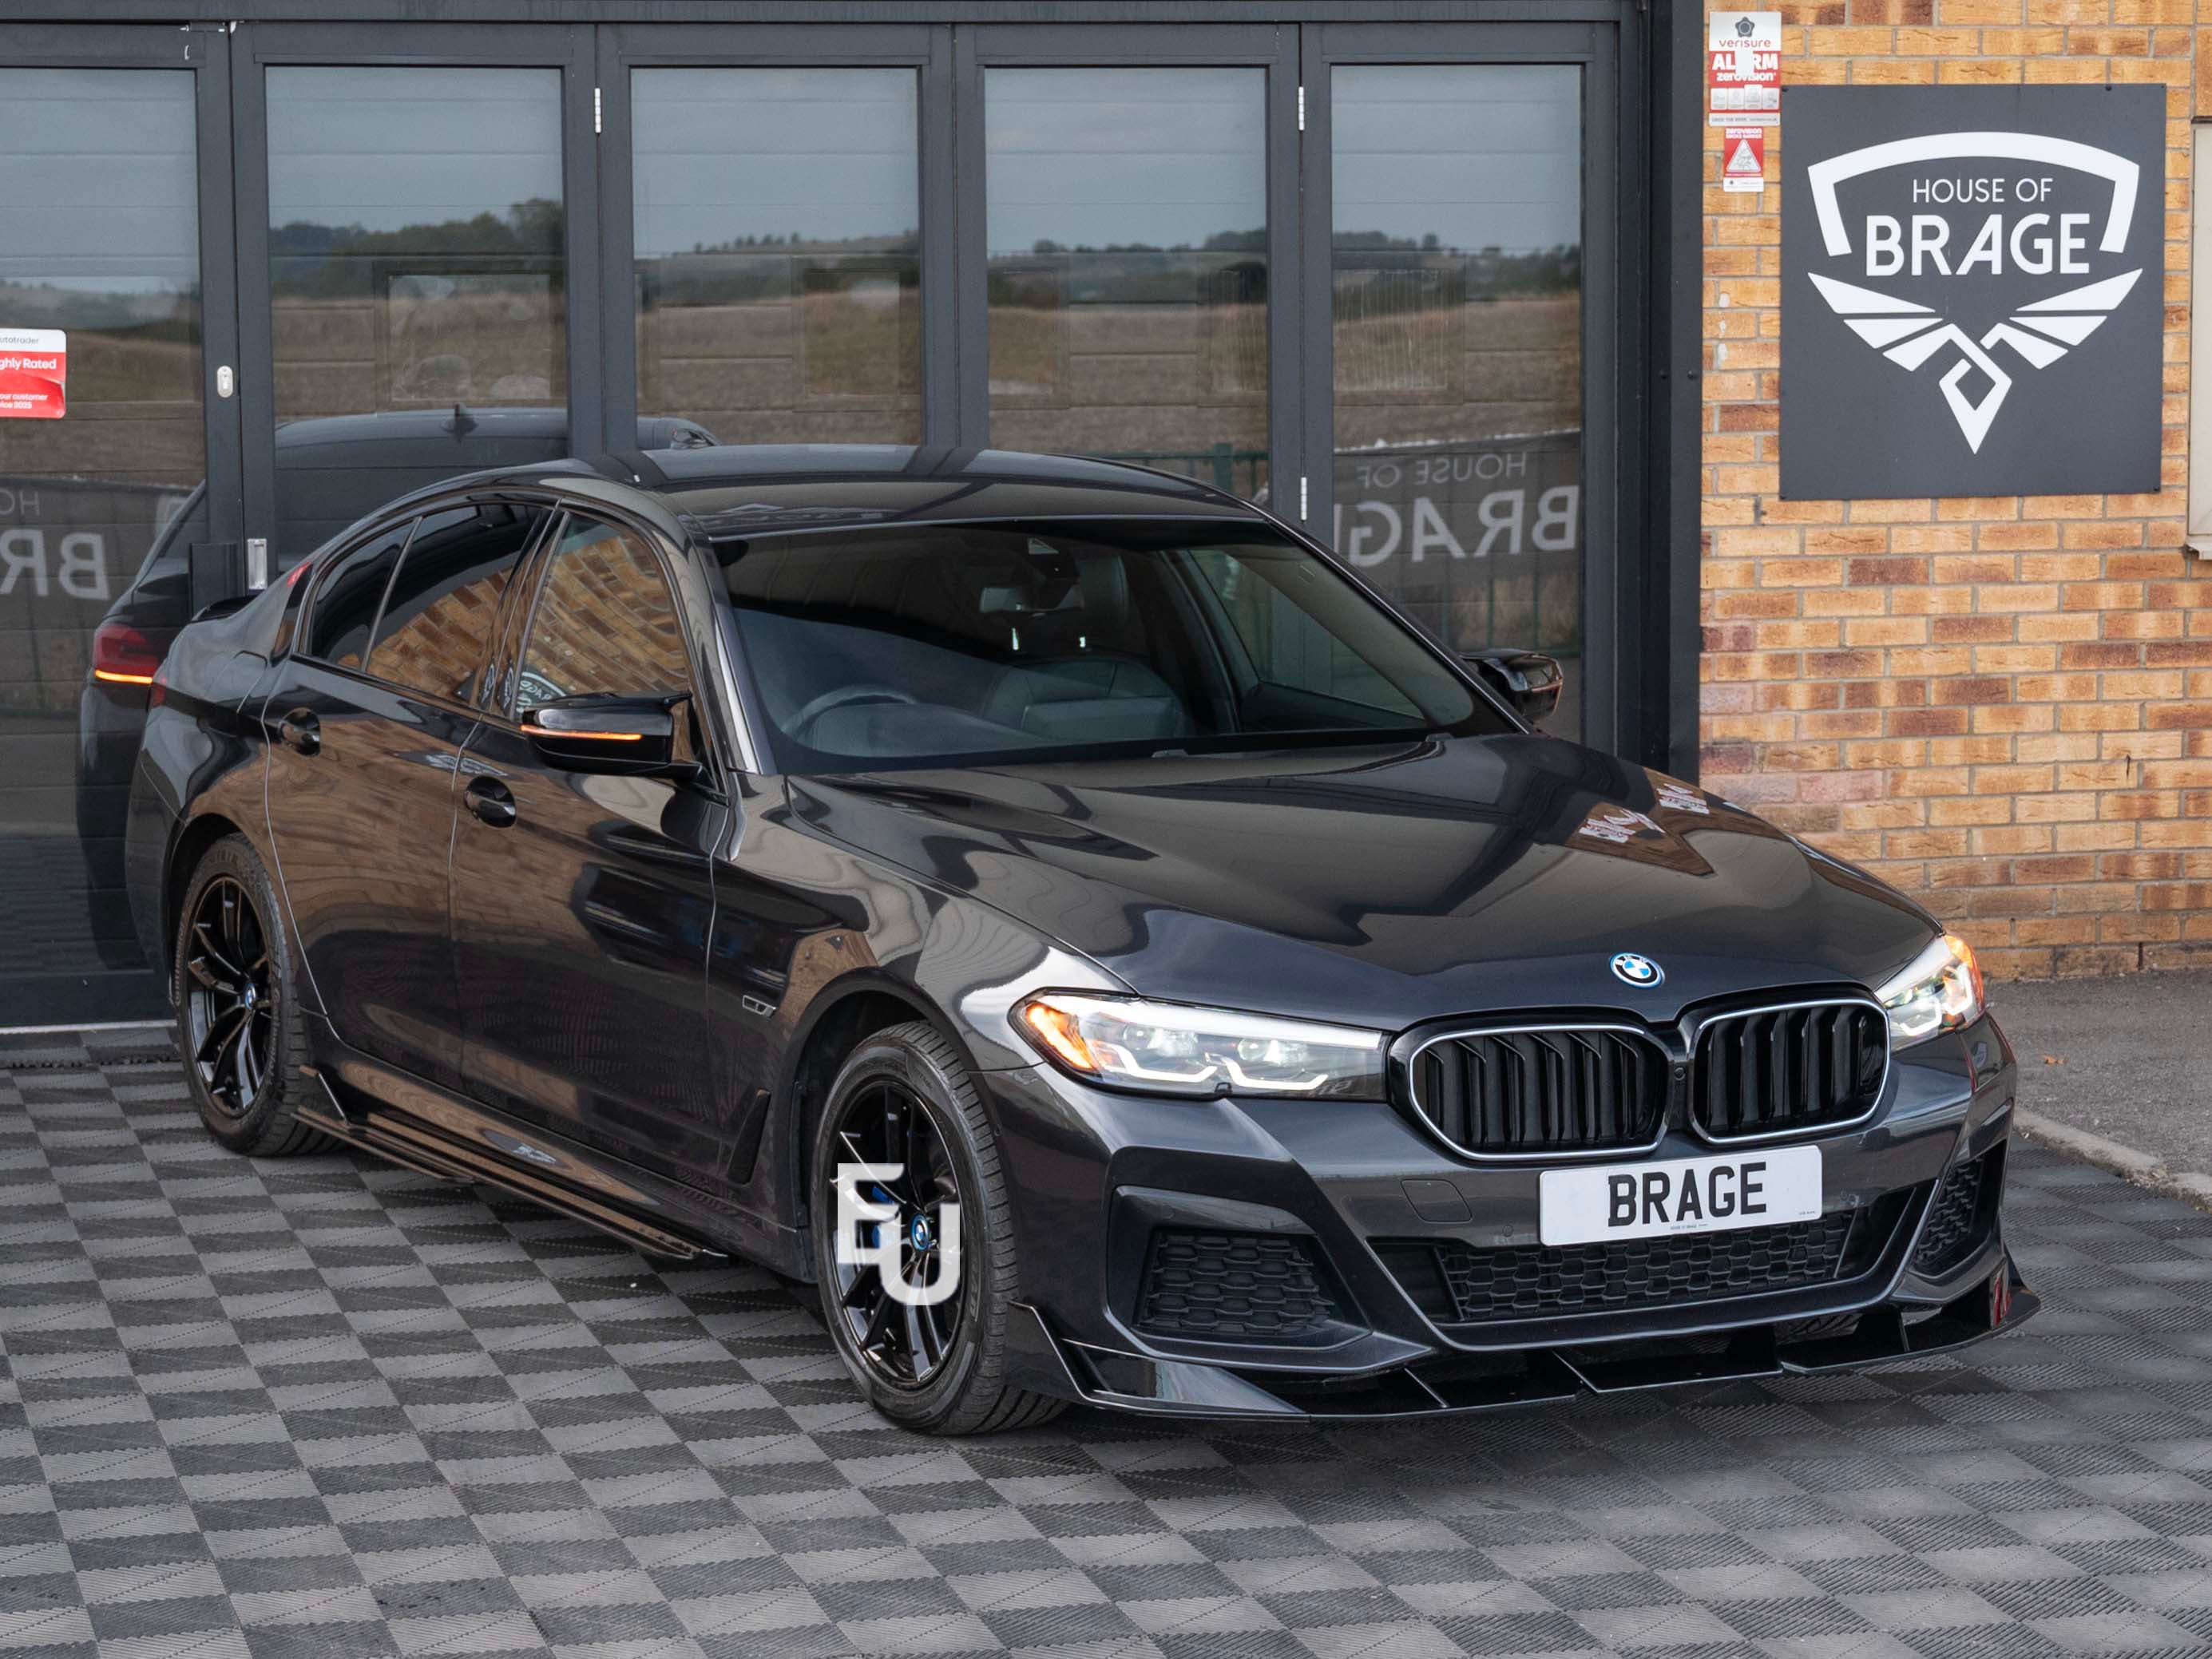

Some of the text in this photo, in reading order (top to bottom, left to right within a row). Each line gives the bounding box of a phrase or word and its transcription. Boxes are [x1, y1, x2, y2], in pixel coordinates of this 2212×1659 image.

[1718, 39, 1771, 48] verisure
[1711, 53, 1779, 71] ALRM
[1913, 178, 2053, 204] HOUSE OF
[1865, 212, 2091, 277] BRAGE
[22, 358, 57, 370] Rated
[1607, 1162, 1766, 1227] BRAGE
